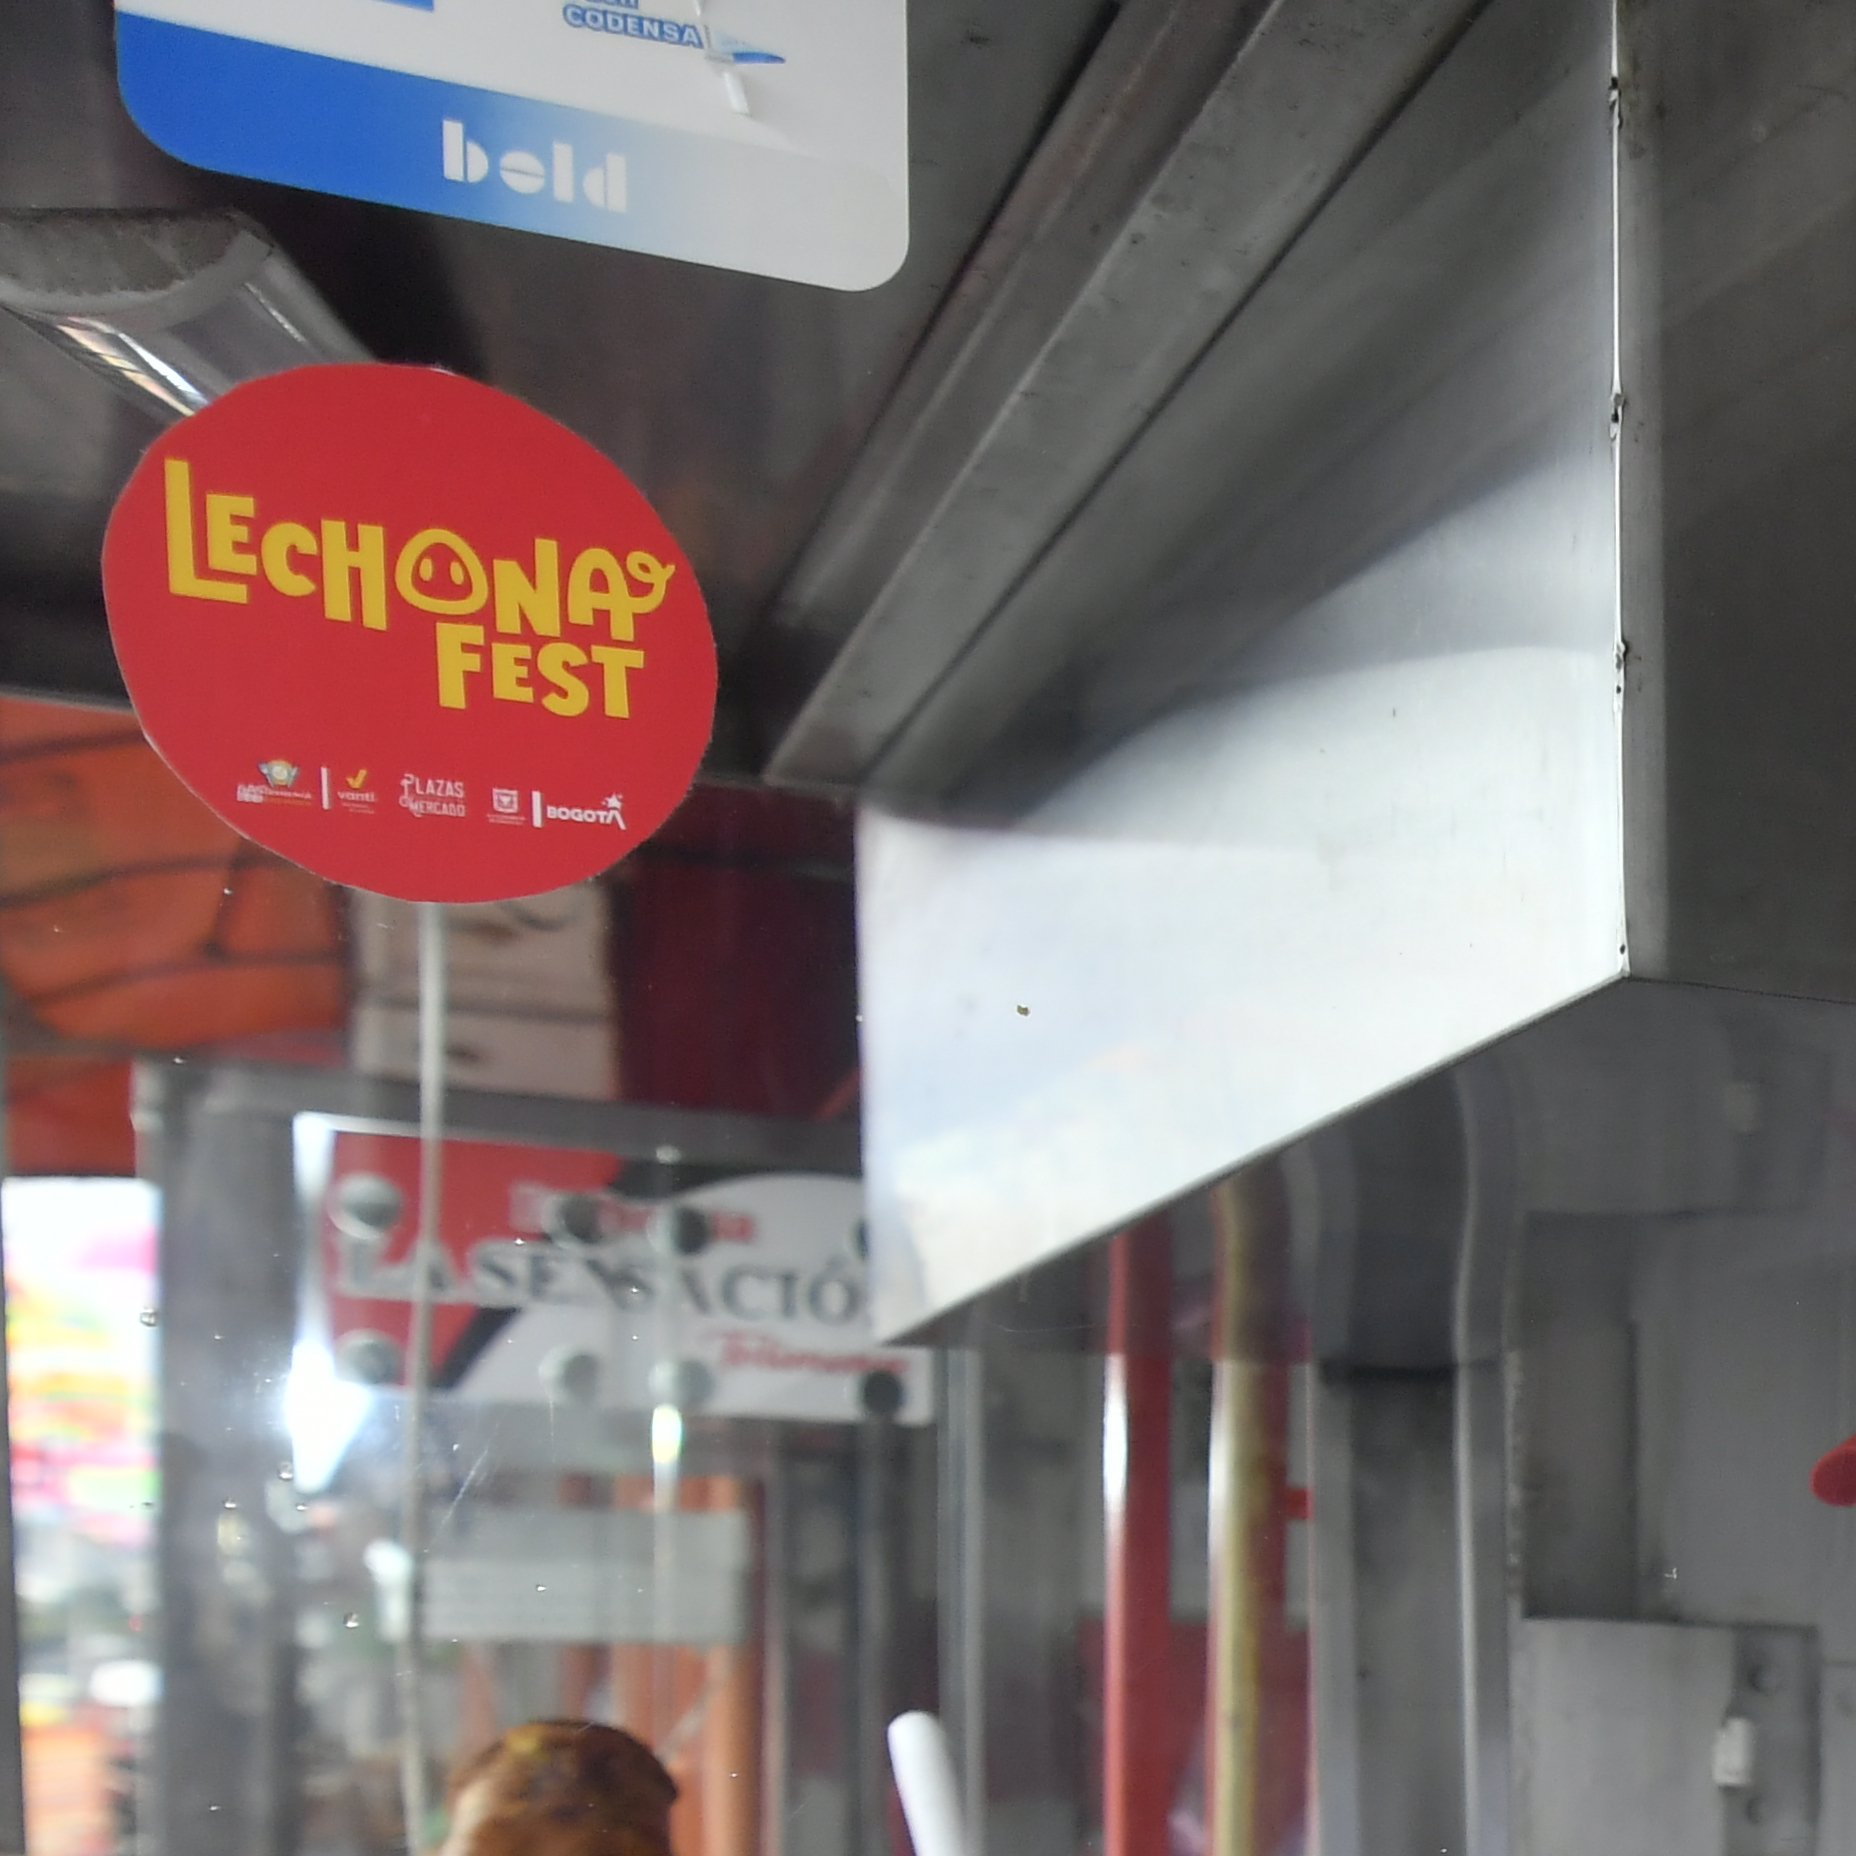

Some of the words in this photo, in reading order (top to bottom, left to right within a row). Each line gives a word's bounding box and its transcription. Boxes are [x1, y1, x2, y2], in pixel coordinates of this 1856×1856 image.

[563, 4, 704, 49] CODENSA
[443, 119, 627, 213] bold
[165, 458, 675, 642] LECHONA
[436, 622, 645, 719] FEST
[472, 1242, 868, 1326] SENSACIÓ
